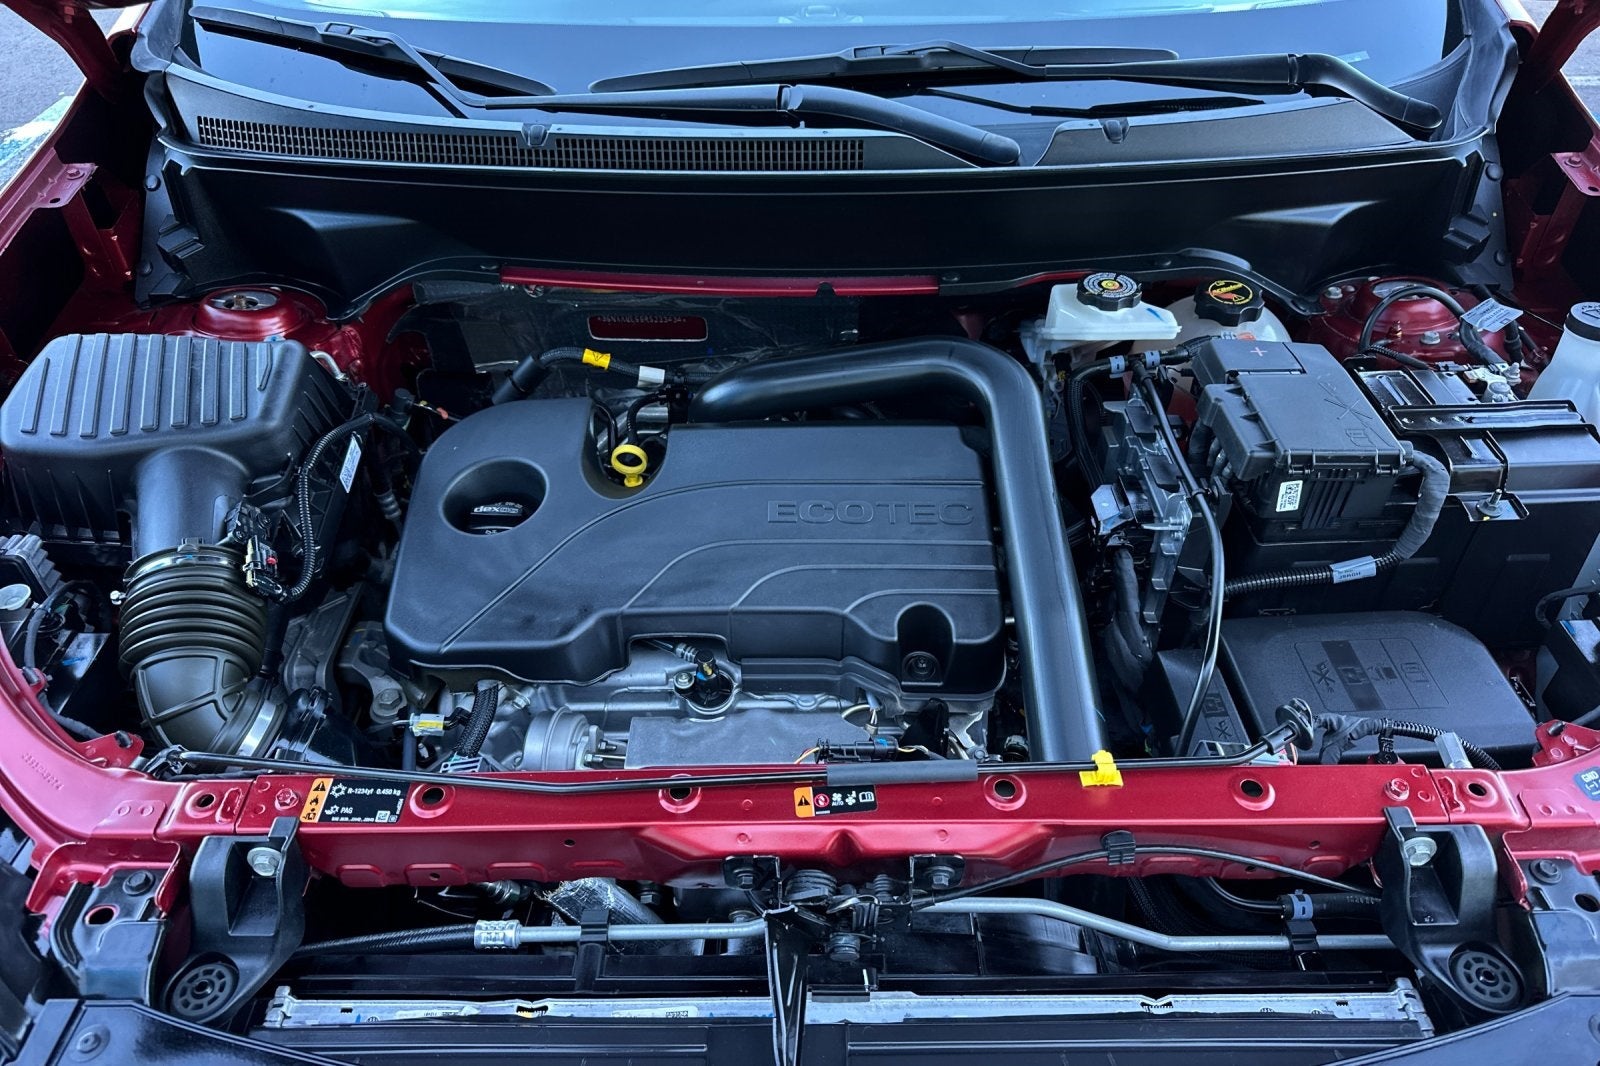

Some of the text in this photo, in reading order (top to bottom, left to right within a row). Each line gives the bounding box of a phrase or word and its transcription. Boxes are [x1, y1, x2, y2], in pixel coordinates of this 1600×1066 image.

[473, 505, 519, 514] dexos
[767, 499, 975, 525] ECOTEC
[1581, 770, 1599, 783] GND
[347, 787, 374, 796] R-1234yf
[393, 788, 402, 797] kg
